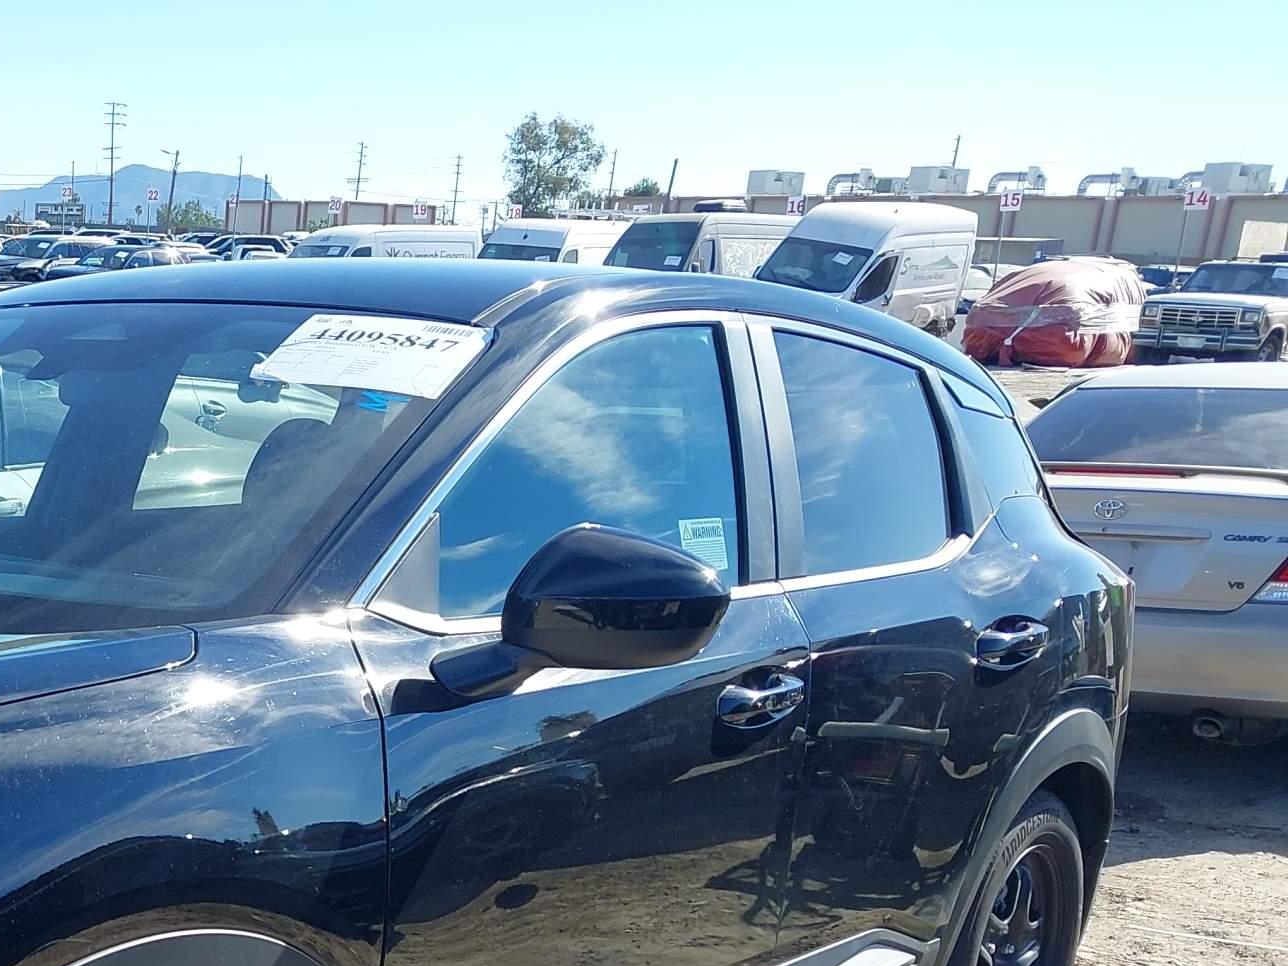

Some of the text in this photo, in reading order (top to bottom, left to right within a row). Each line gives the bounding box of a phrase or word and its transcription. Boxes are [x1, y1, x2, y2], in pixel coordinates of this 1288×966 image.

[62, 187, 72, 197] 23
[148, 190, 159, 201] 22
[1185, 190, 1209, 206] 14
[329, 199, 342, 211] 20
[1001, 192, 1021, 207] 15
[413, 204, 427, 216] 19
[509, 207, 522, 219] 18
[787, 200, 805, 214] 16
[309, 327, 460, 352] 44095847
[1223, 534, 1273, 543] CAMRY
[1228, 581, 1245, 590] V6
